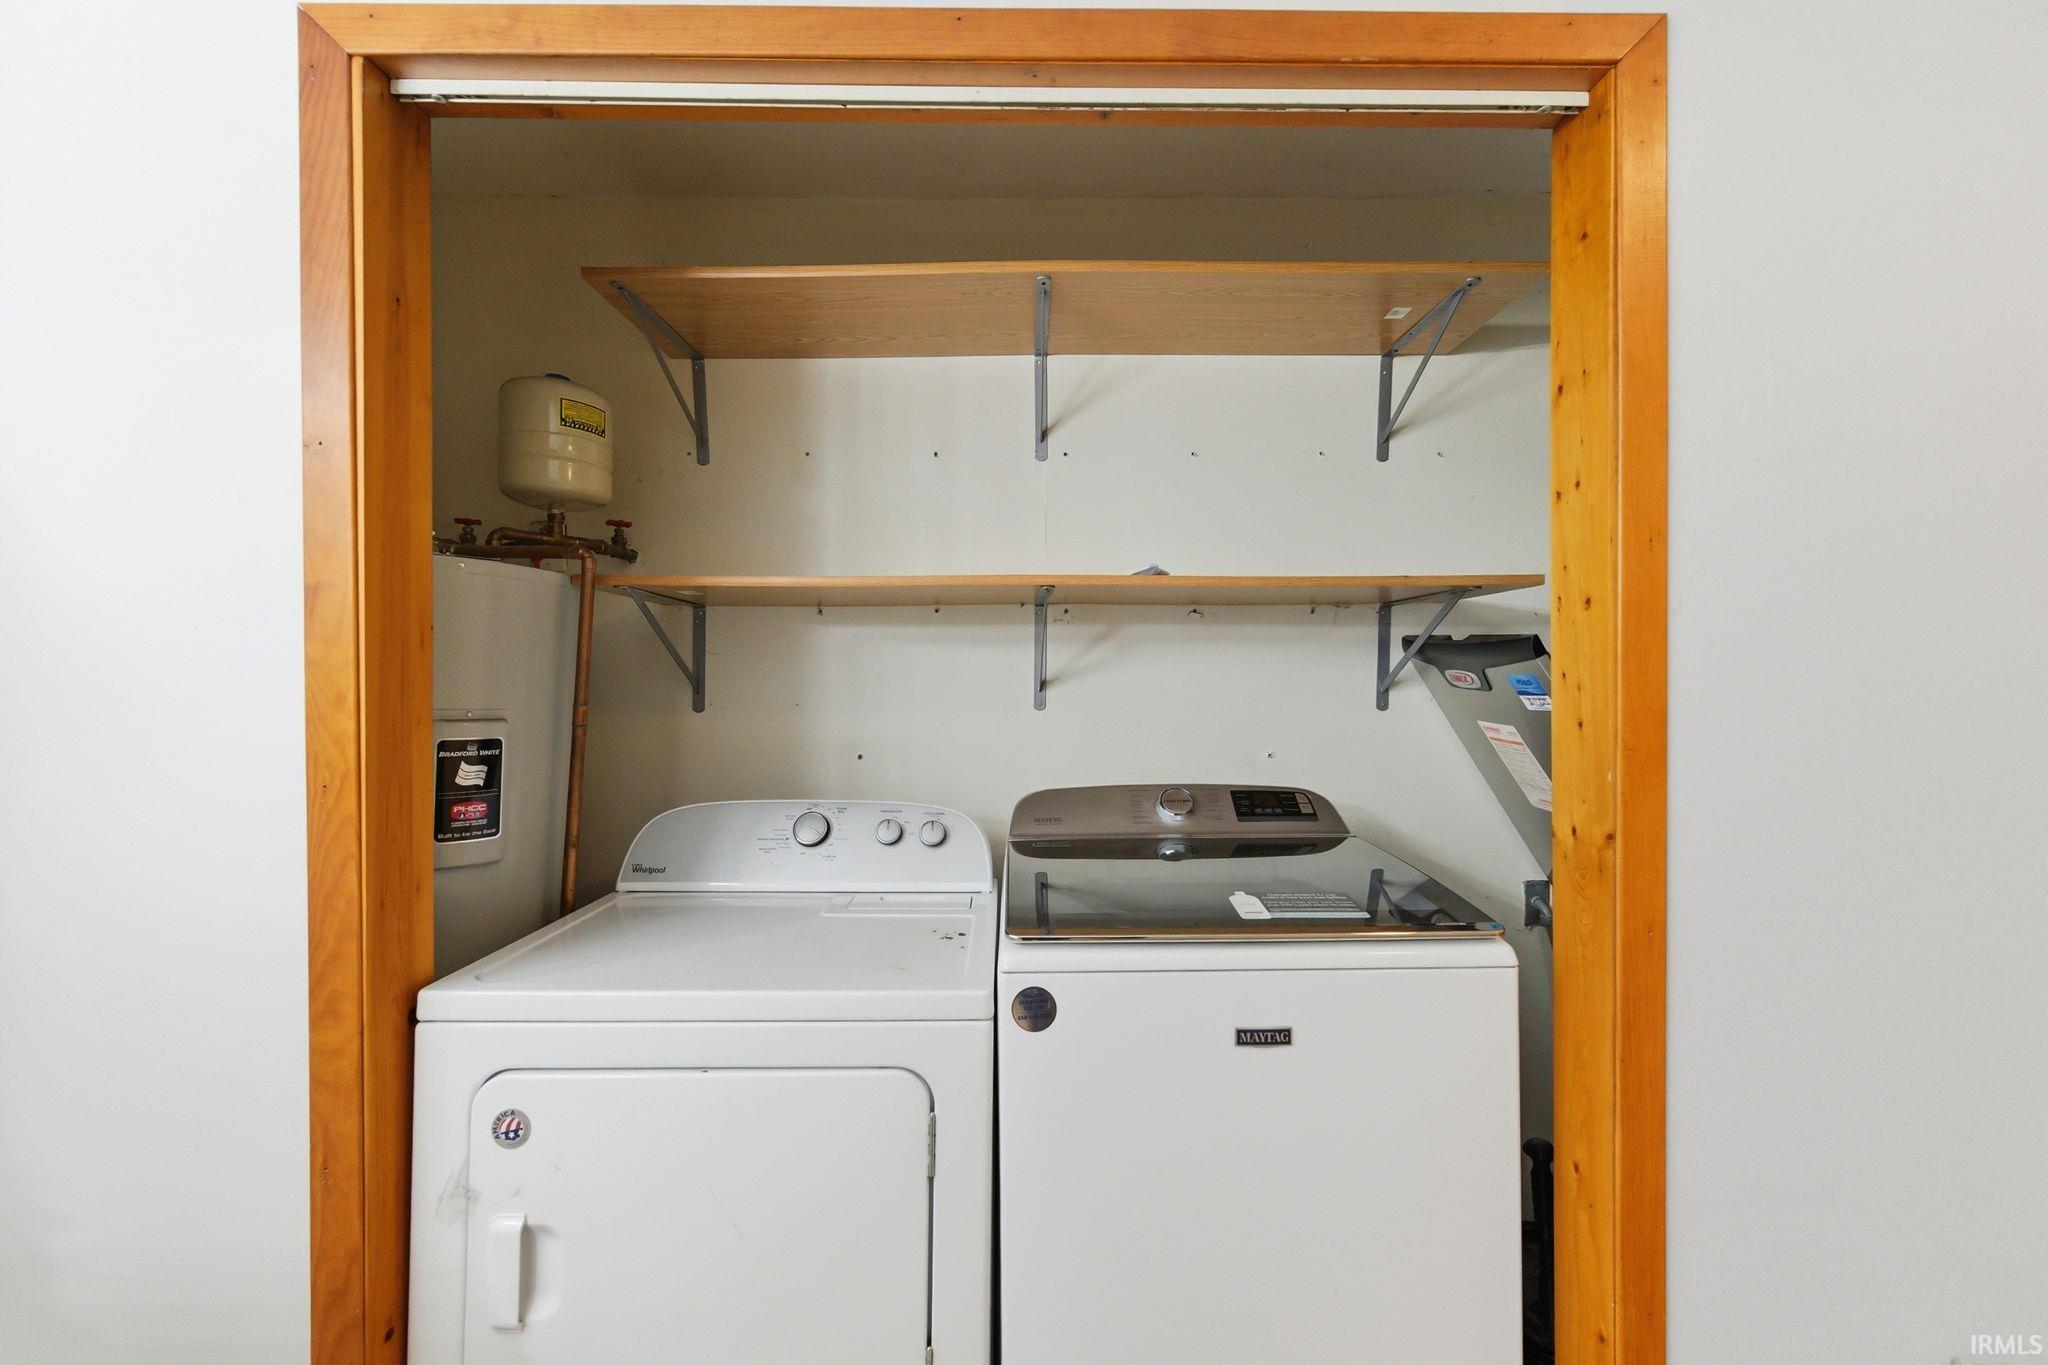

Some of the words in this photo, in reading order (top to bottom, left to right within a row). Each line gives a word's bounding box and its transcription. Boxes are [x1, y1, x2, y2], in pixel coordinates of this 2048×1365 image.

[453, 804, 487, 813] PHCC
[632, 865, 666, 875] Whirlpool
[1239, 1031, 1290, 1044] MAYTAG
[493, 1110, 516, 1140] AMERICA
